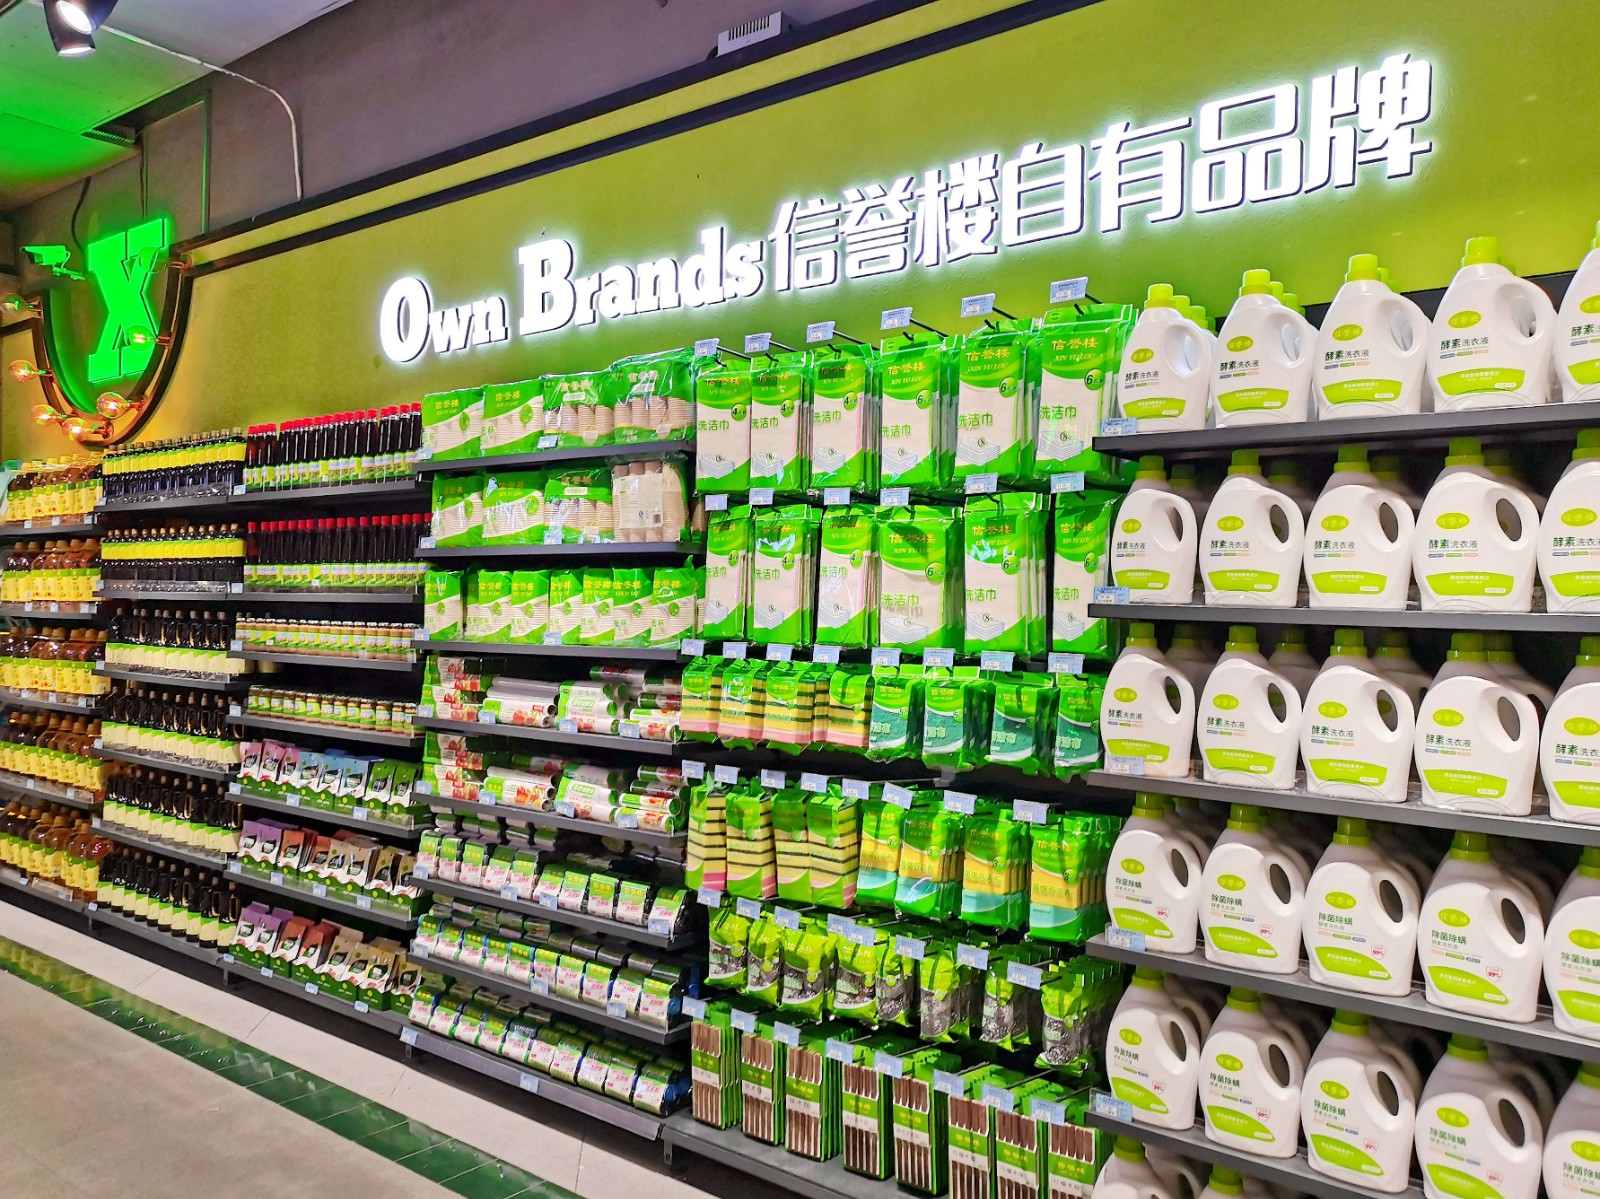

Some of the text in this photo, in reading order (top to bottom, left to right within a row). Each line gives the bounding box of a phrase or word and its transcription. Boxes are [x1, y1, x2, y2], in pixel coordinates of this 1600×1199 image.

[379, 52, 1435, 363] Own Brands 信誉楼自有品牌
[1051, 336, 1099, 352] 信誉楼
[1440, 336, 1489, 351] 酵素洗衣液
[965, 347, 1011, 364] 信誉楼
[1324, 348, 1370, 362] 酵素洗衣液
[887, 361, 927, 378] 信誉楼
[1219, 360, 1259, 372] 酵素洗衣液
[1125, 371, 1159, 382] 酵素洗衣液
[972, 525, 1012, 537] 信誉楼
[889, 533, 937, 547] 信誉楼
[1116, 540, 1146, 551] 酵素洗衣液
[1210, 539, 1250, 550] 酵素洗衣液
[1313, 539, 1355, 550] 酵素洗衣液
[1428, 538, 1478, 550] 酵素洗衣液
[1108, 708, 1143, 721] 酵素洗衣液
[1206, 716, 1246, 731] 酵素洗衣液
[1312, 725, 1355, 738] 酵素洗衣液
[1426, 733, 1472, 748] 酵素洗衣液
[1115, 877, 1143, 890] 除菌除螨
[1211, 893, 1243, 908] 除菌除螨
[1319, 912, 1353, 926] 除菌除螨
[1432, 929, 1467, 945] 除菌除螨
